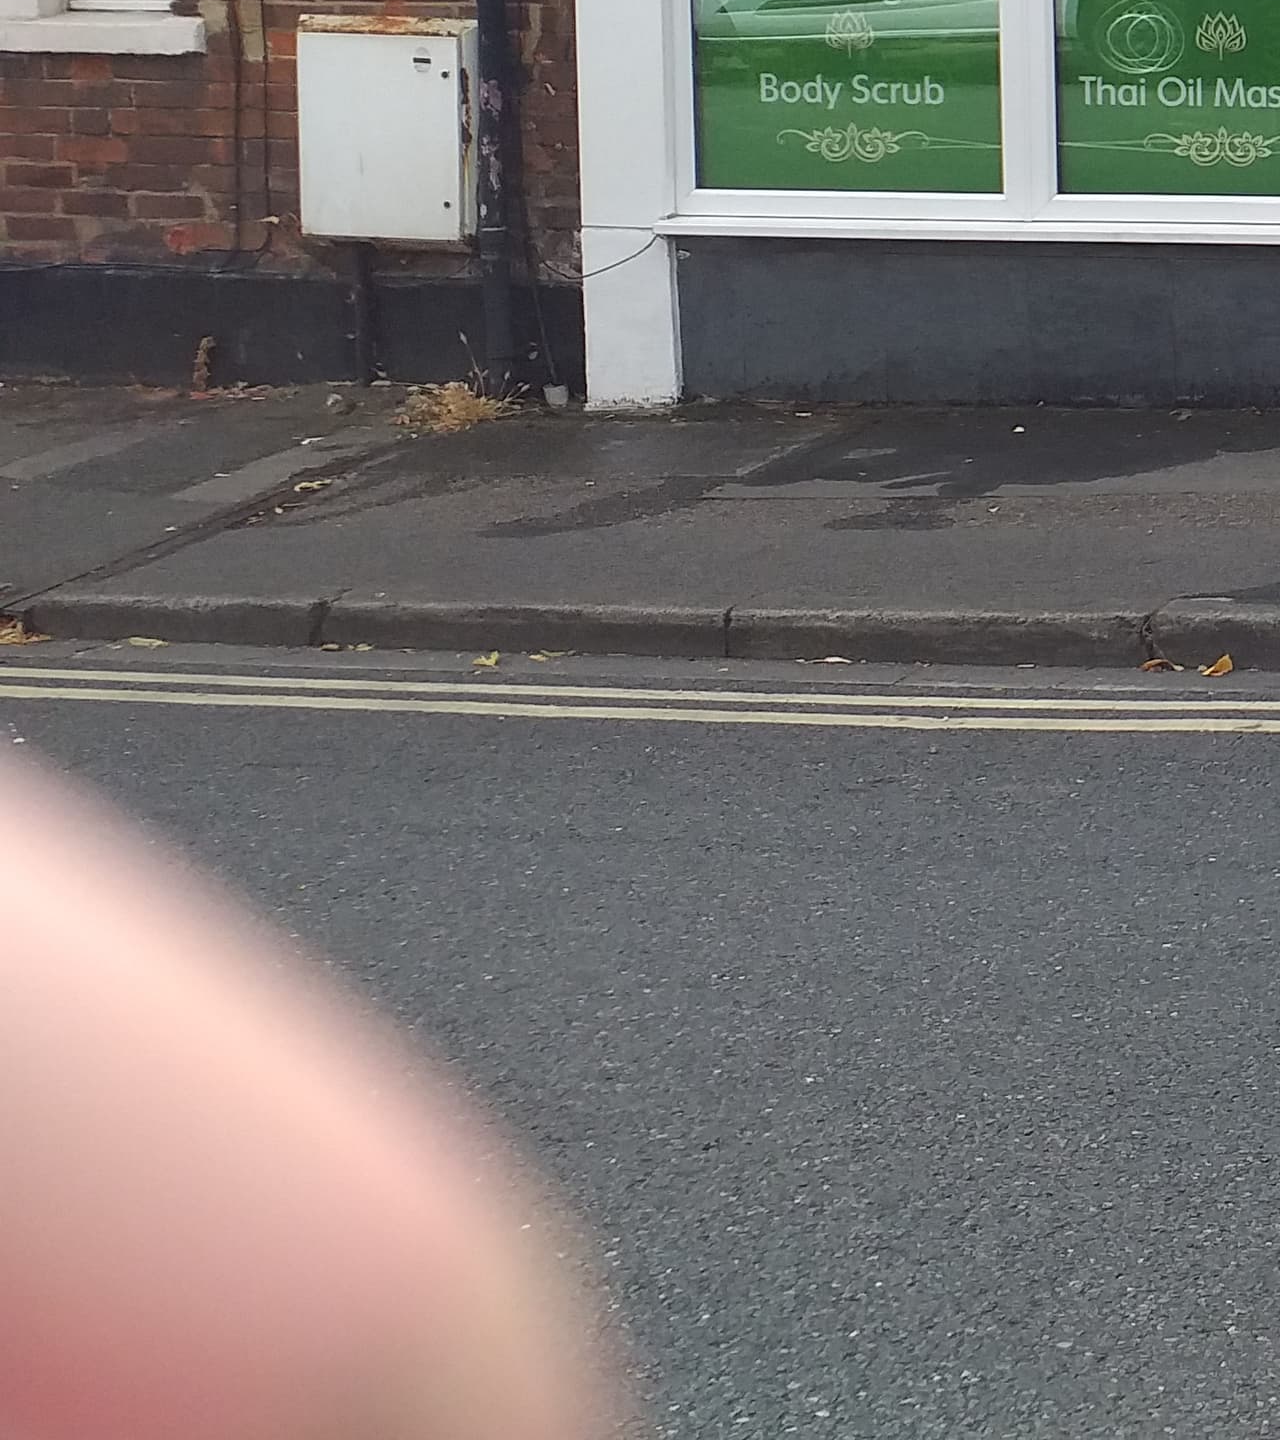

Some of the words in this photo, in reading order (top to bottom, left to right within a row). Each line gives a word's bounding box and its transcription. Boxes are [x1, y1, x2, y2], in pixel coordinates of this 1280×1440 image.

[760, 73, 842, 110] Body
[851, 74, 944, 105] Scrub
[1078, 75, 1146, 106] Thai
[1157, 75, 1203, 107] Oil
